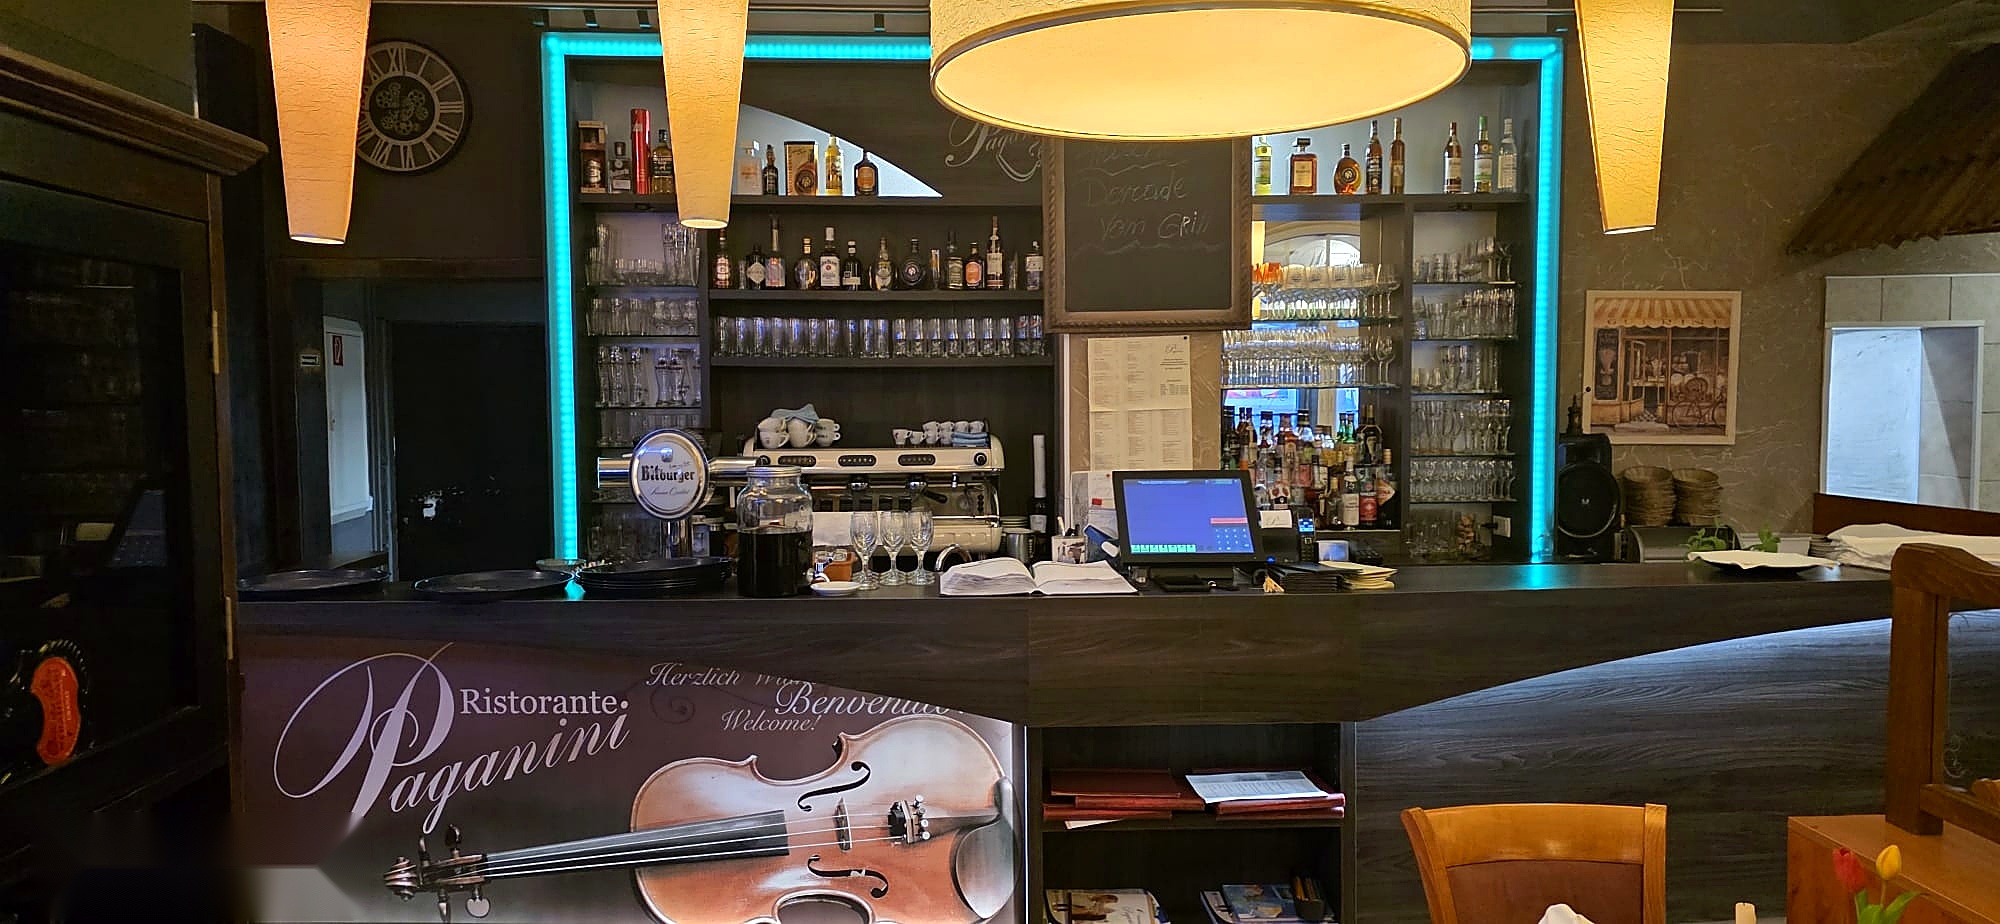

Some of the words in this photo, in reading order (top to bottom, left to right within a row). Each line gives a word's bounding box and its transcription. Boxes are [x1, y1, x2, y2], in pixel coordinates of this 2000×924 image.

[640, 464, 696, 484] Bitburger
[646, 662, 740, 686] Herzlich
[459, 687, 618, 715] Ristorante
[721, 708, 822, 731] Welcome!
[274, 642, 631, 834] Paganini
